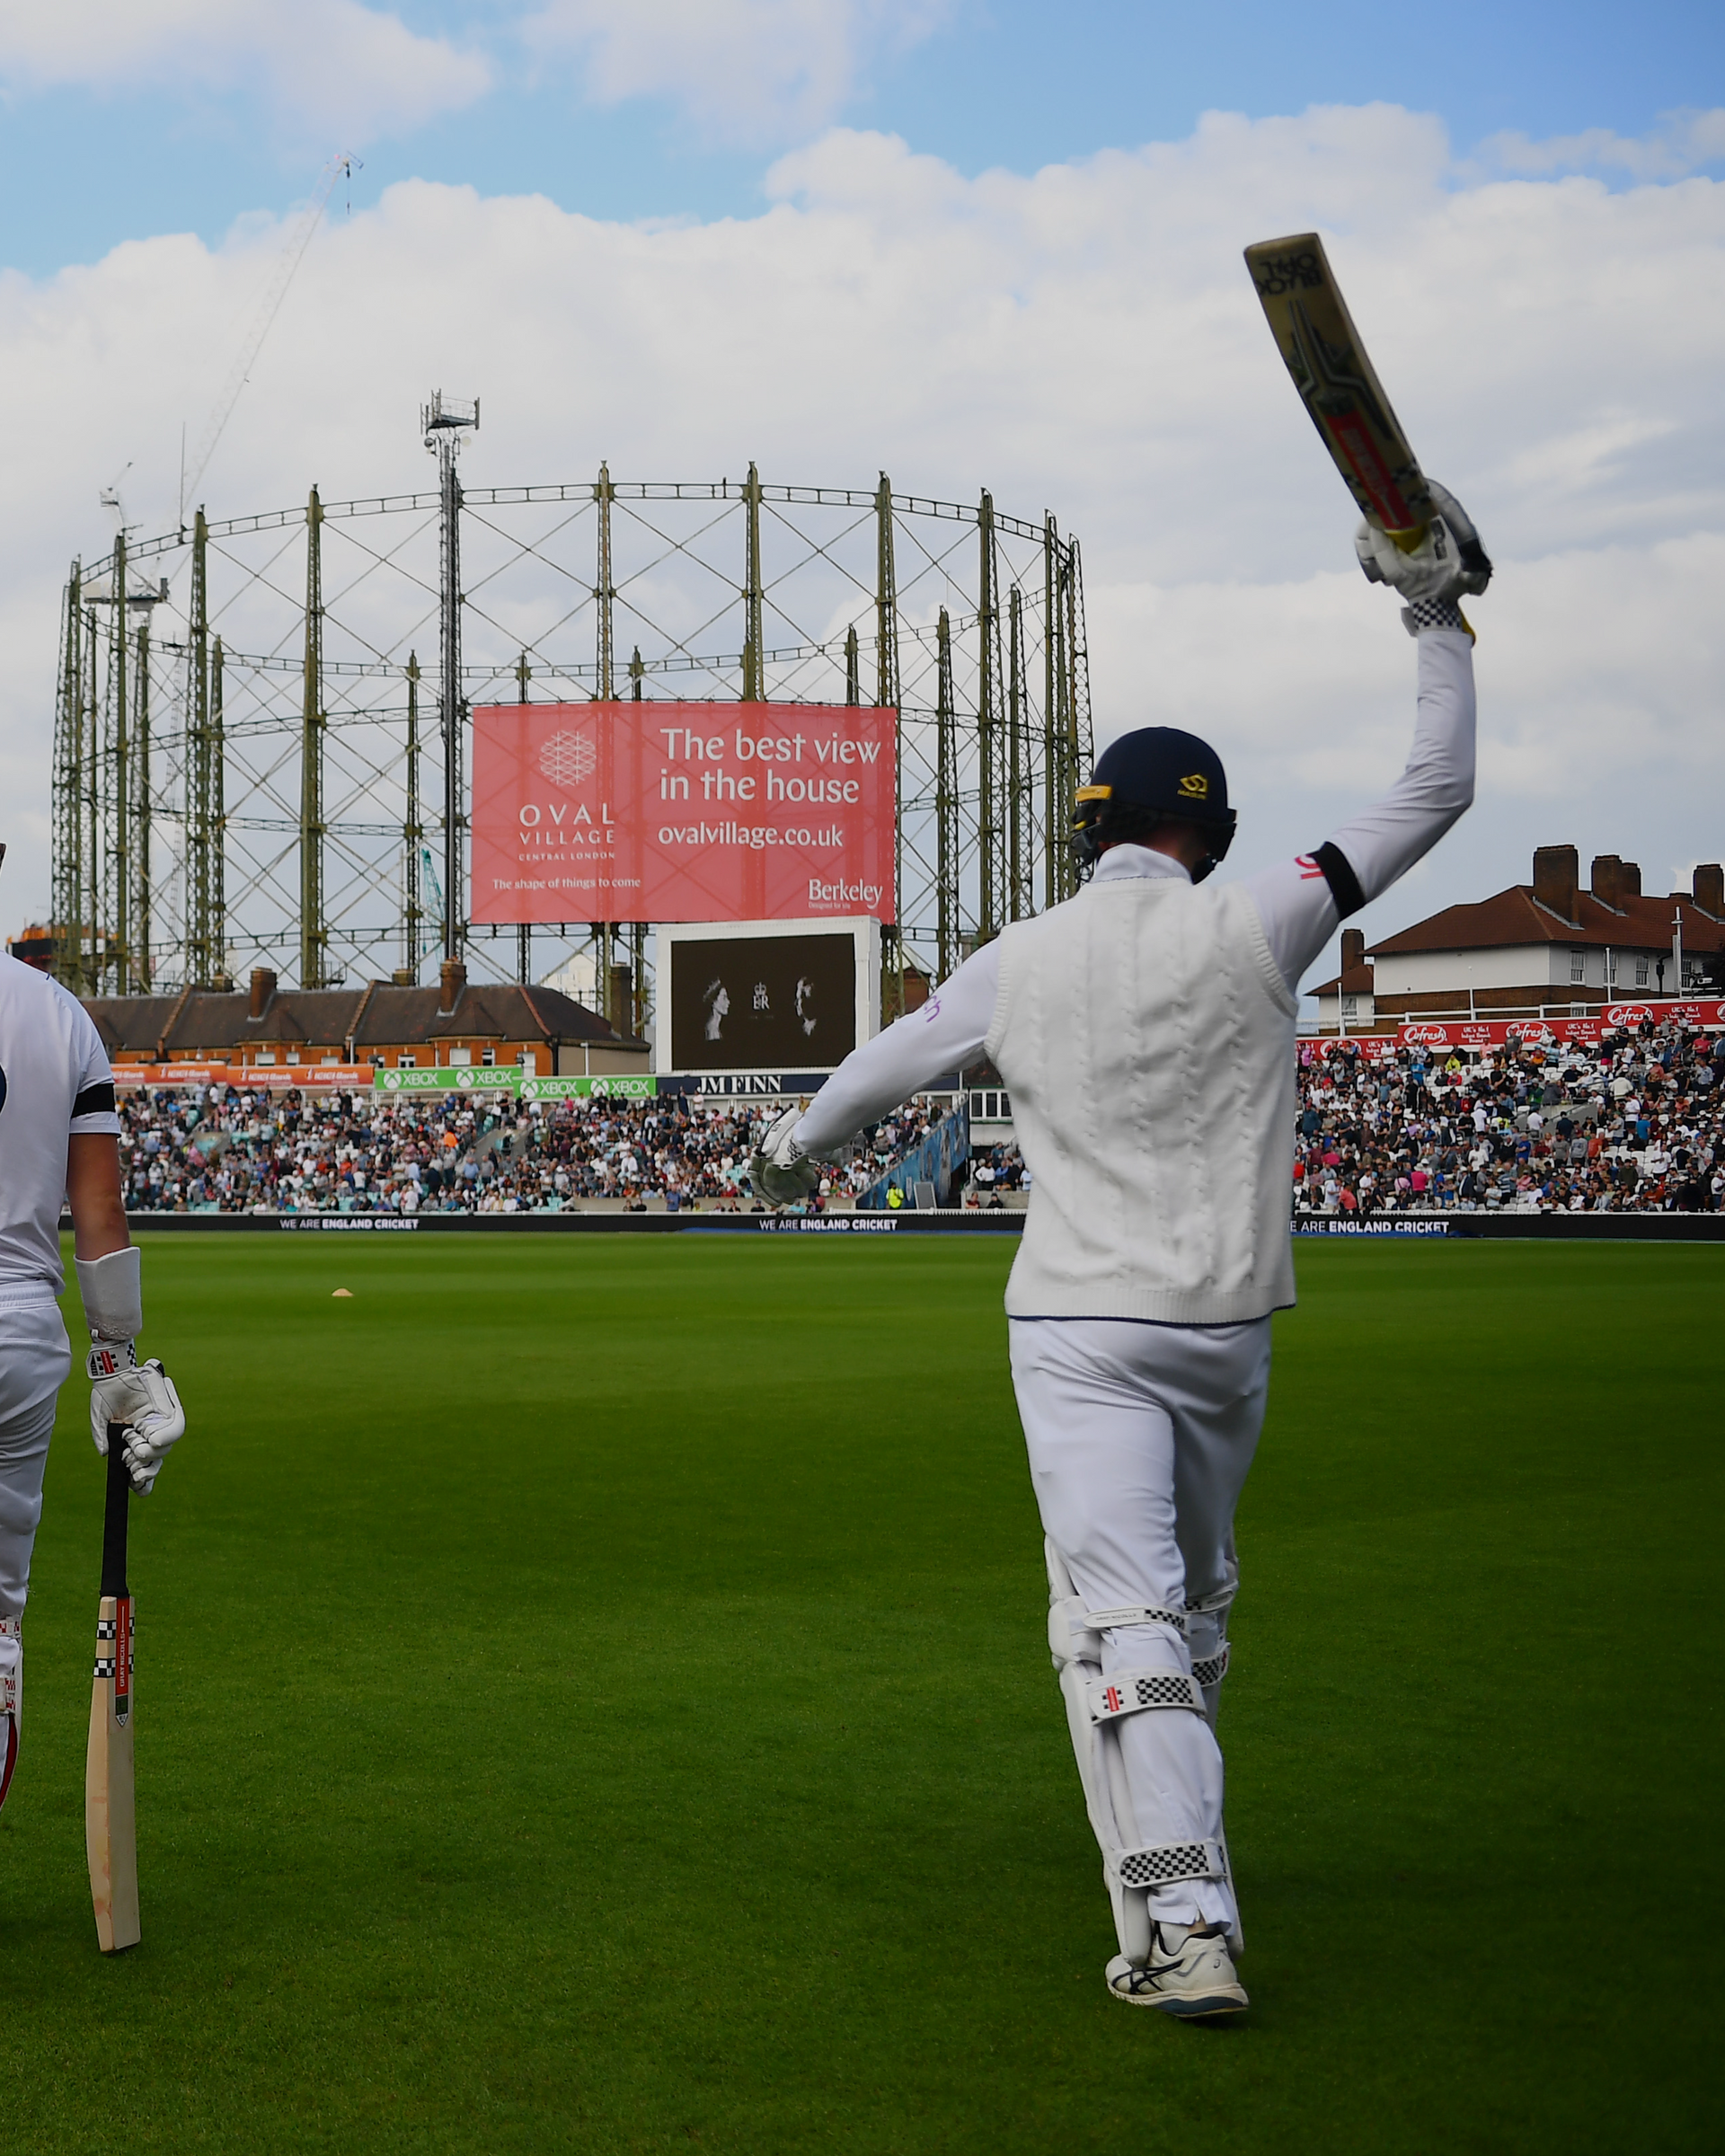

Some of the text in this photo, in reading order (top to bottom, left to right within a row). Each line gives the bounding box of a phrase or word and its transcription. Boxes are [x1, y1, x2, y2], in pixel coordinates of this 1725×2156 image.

[659, 728, 881, 764] The best view
[660, 768, 859, 803] in the house
[519, 802, 615, 827] OVAL
[519, 829, 615, 845] VILLAGE
[658, 821, 844, 850] ovalvillage.co.uk
[518, 852, 615, 862] CENTRAL LONDON
[493, 878, 641, 890] The shape of things to come
[809, 878, 883, 910] Berkeley
[1405, 1026, 1446, 1045] Cofresh
[402, 1072, 438, 1086] XBOX
[476, 1070, 511, 1084] XBOX
[540, 1081, 578, 1095] XBOX
[611, 1080, 650, 1094] XBOX
[696, 1075, 782, 1094] JM FINN
[279, 1218, 419, 1229] WE ARE ENGLAND CRICKET
[759, 1219, 898, 1231] WE ARE ENGLAND CRICKET
[1300, 1221, 1326, 1233] ARE
[1329, 1221, 1392, 1233] ENGLAND
[1394, 1221, 1449, 1233] CRICKET
